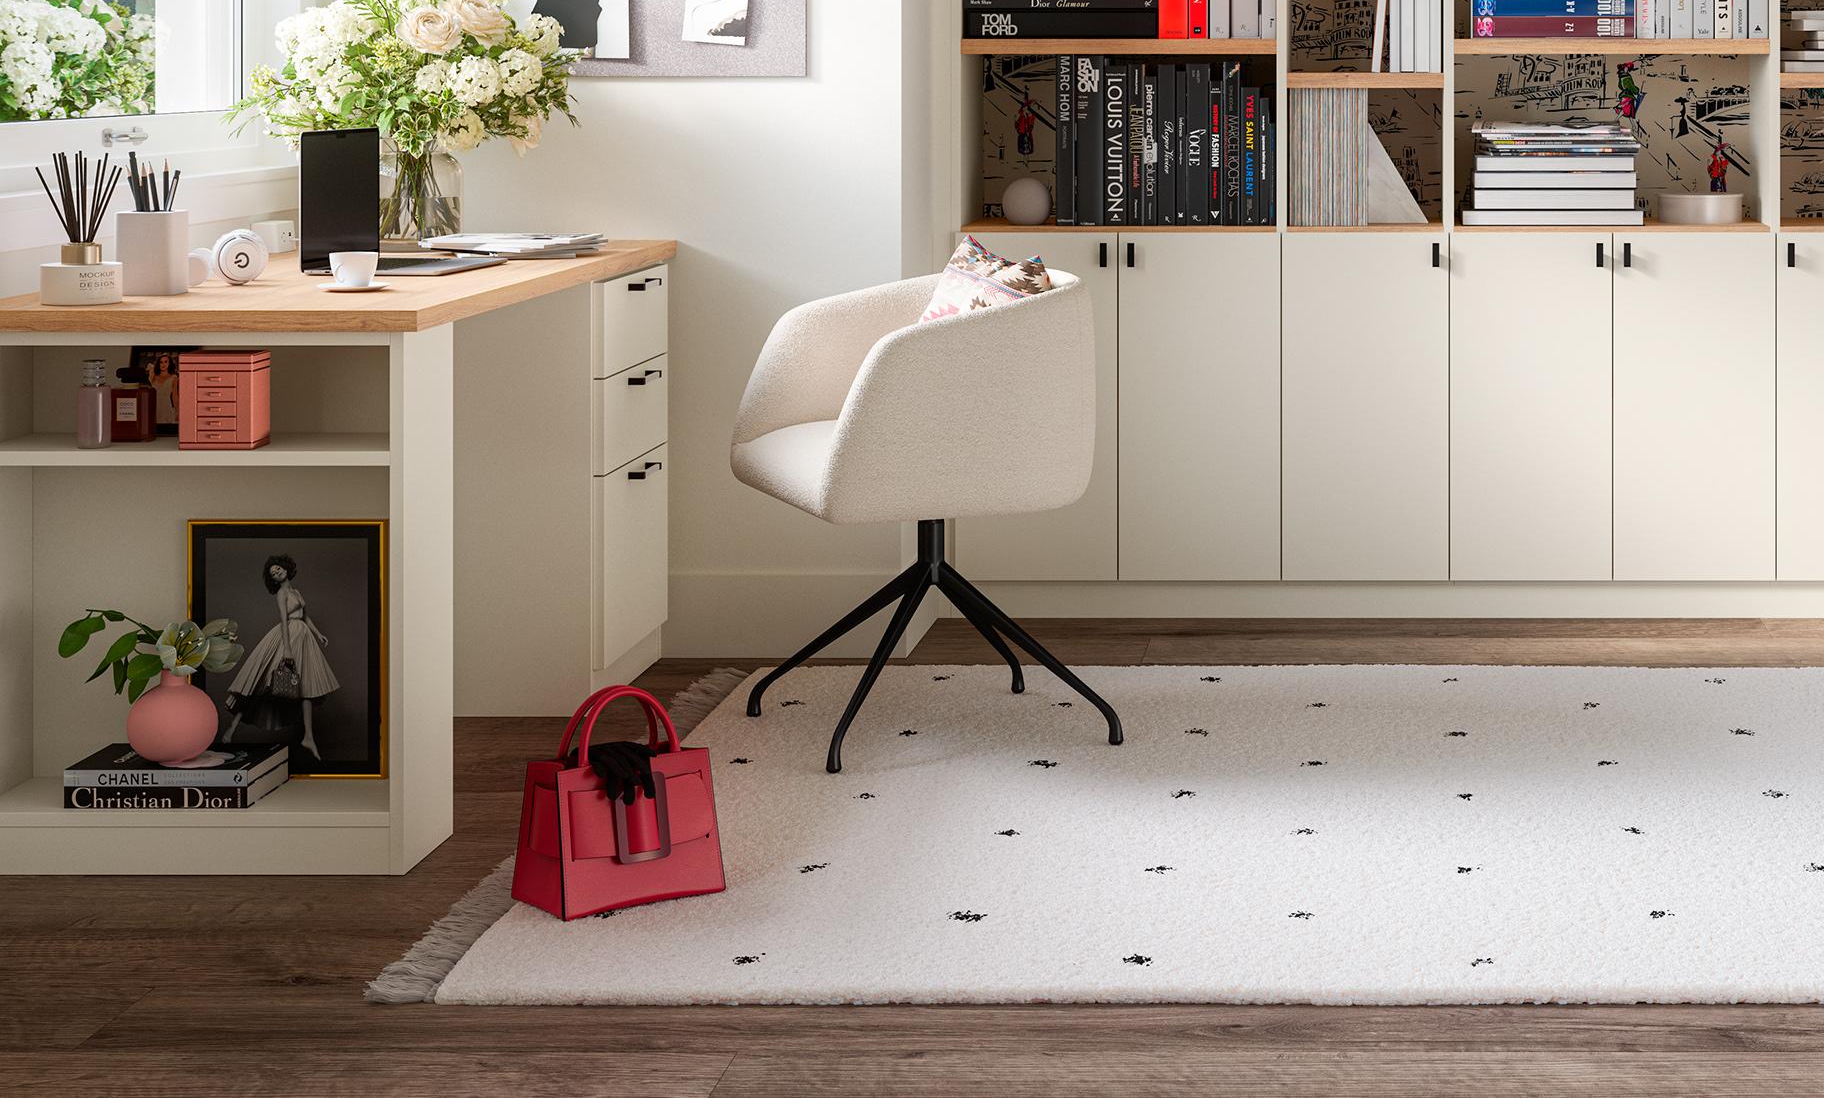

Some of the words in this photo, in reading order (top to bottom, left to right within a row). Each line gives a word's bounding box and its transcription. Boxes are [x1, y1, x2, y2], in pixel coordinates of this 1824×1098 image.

[1056, 0, 1090, 8] Glamour
[981, 13, 1012, 25] TOM
[981, 24, 1018, 36] FORD
[1597, 18, 1611, 37] 100
[1059, 56, 1070, 92] MARC
[1059, 93, 1070, 122] HOM
[1107, 78, 1123, 129] LOUIS
[1145, 84, 1155, 117] pierre
[1245, 94, 1254, 119] YVES
[1145, 117, 1157, 151] cardin
[1162, 120, 1175, 150] Roger
[1213, 126, 1219, 134] OF
[1228, 114, 1240, 154] MARCEL
[1245, 121, 1254, 150] SAINT
[1188, 129, 1201, 166] VOGUE
[1211, 133, 1220, 168] FASHION
[1107, 133, 1124, 212] VUITTON
[1146, 151, 1156, 197] evolution
[1163, 150, 1175, 175] Vivier
[1228, 155, 1240, 198] ROCHAS
[1245, 151, 1254, 196] LAURENT
[79, 270, 115, 279] MOCKUP
[98, 773, 159, 786] CHANEL
[71, 787, 172, 809] Christian
[180, 787, 232, 809] Dior
